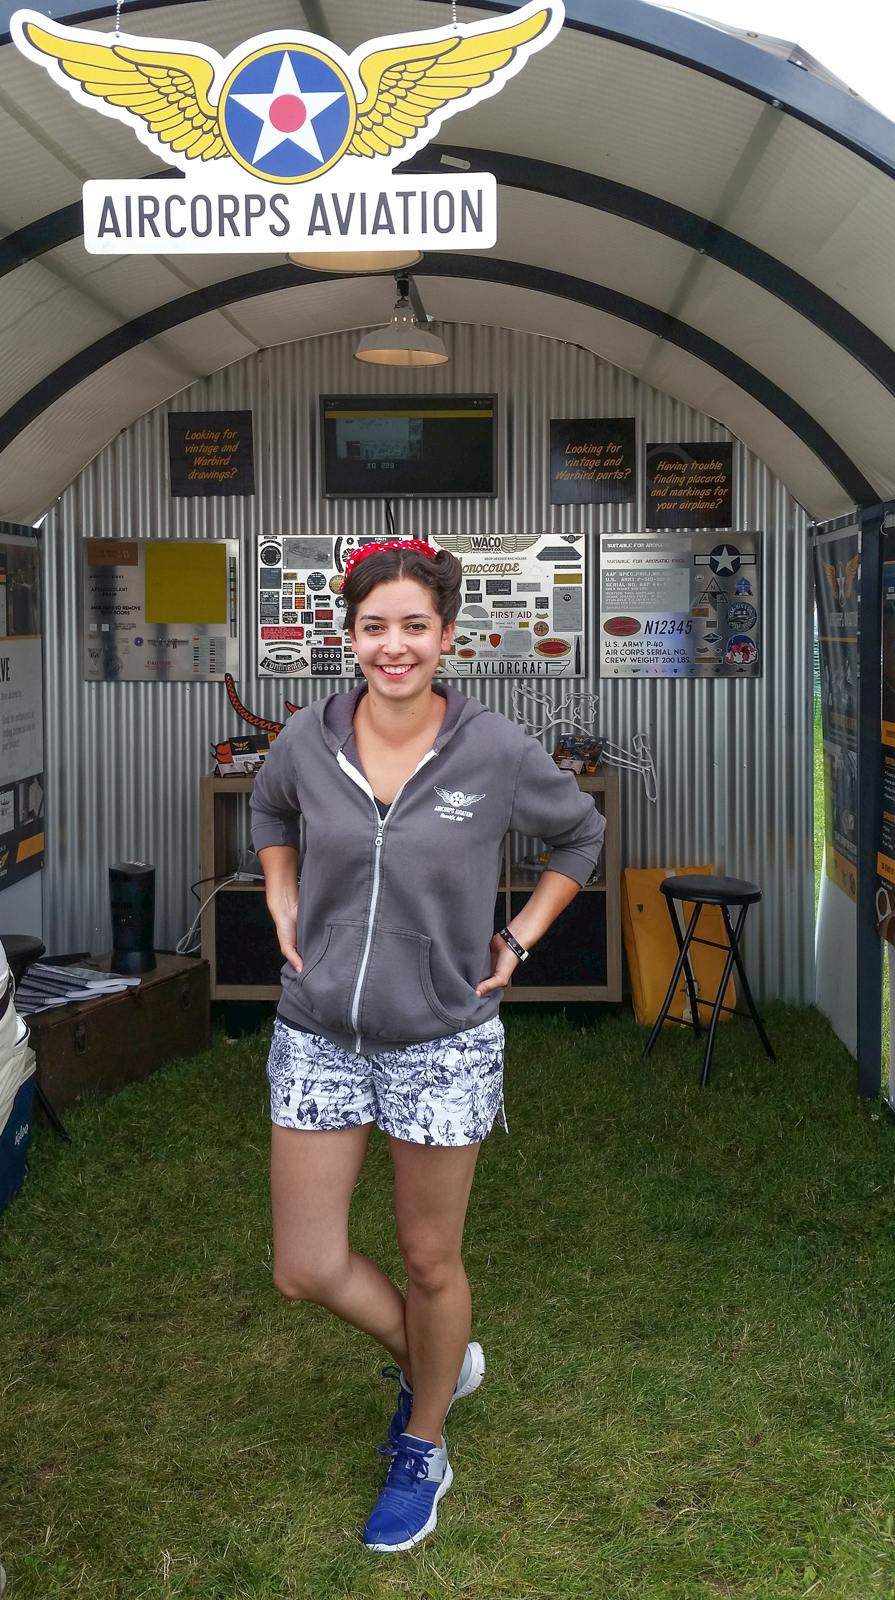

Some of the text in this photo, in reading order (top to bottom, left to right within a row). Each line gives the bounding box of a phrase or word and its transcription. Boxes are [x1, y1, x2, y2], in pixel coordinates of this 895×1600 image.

[97, 189, 483, 238] AIRCORPS AVIATION
[184, 429, 238, 442] Looking for
[185, 441, 240, 455] vintage and
[565, 442, 622, 456] Looking for
[194, 455, 231, 466] Warbird
[565, 455, 624, 470] vintage and
[657, 460, 723, 473] Having trouble
[188, 468, 238, 481] drawings?
[555, 468, 631, 482] Warbird parts?
[653, 473, 726, 486] finding placards
[651, 486, 728, 499] and markings for
[656, 499, 723, 512] your airplane?
[472, 537, 501, 548] WACO
[461, 562, 520, 577] onocoupe
[490, 611, 532, 619] FIRST AID
[644, 620, 693, 635] N12345
[265, 658, 305, 672] Continental
[469, 661, 550, 674] TAYLORCRAFT
